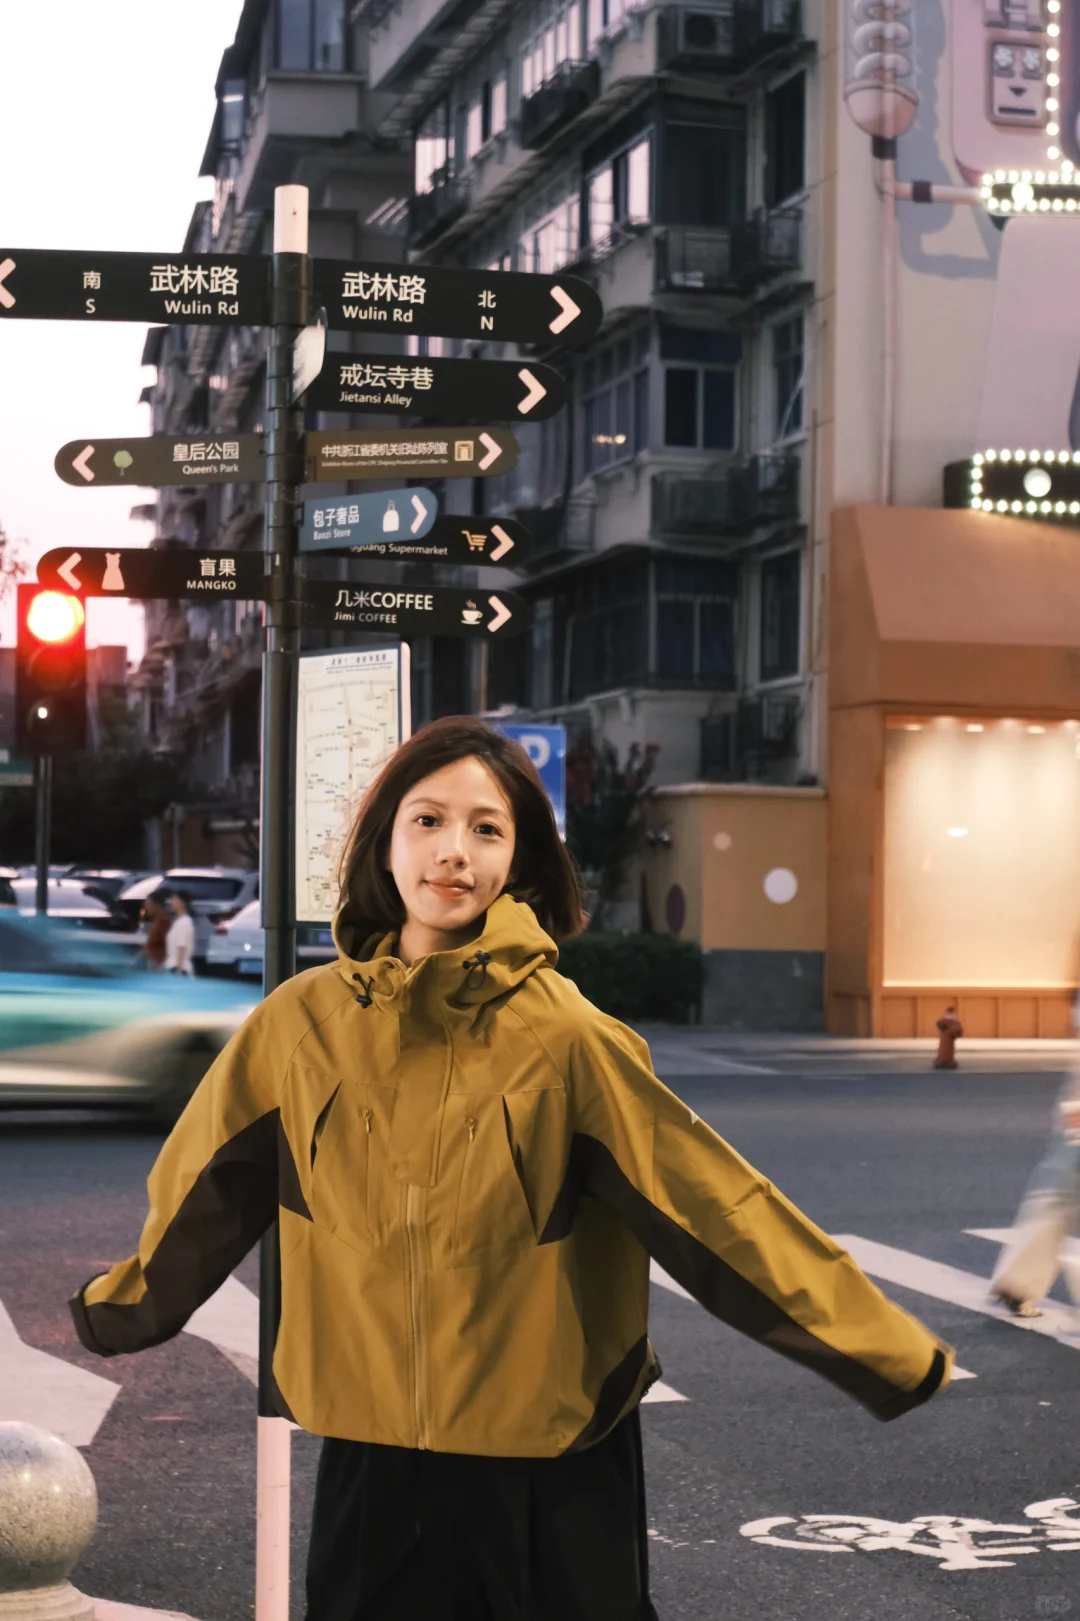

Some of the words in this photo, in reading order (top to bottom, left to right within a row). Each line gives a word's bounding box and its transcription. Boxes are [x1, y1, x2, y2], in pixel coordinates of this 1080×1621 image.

[83, 270, 101, 290] 南
[149, 264, 239, 296] 武林路
[341, 271, 426, 304] 武林路
[86, 298, 96, 313] S
[164, 299, 211, 315] Wulin
[217, 301, 239, 316] Rd
[478, 290, 497, 309] 北
[342, 305, 388, 321] Wulin
[392, 308, 414, 323] Rd
[480, 316, 494, 331] N
[339, 363, 434, 390] 戒坛寺巷
[339, 391, 381, 404] Jietansi
[384, 393, 413, 408] Alley
[172, 442, 240, 462] 皇后公园
[182, 464, 218, 475] Queen's
[219, 463, 240, 473] Park
[313, 505, 360, 528] 包子奢品
[313, 531, 332, 541] Baozi
[333, 529, 352, 539] Store
[388, 543, 449, 556] Supermarket
[199, 558, 237, 577] 盲果
[186, 580, 237, 591] MANGKO
[334, 589, 434, 611] 几米COFFEE
[334, 611, 356, 621] Jimi
[358, 612, 398, 624] COFFEE
[519, 734, 551, 770] P
